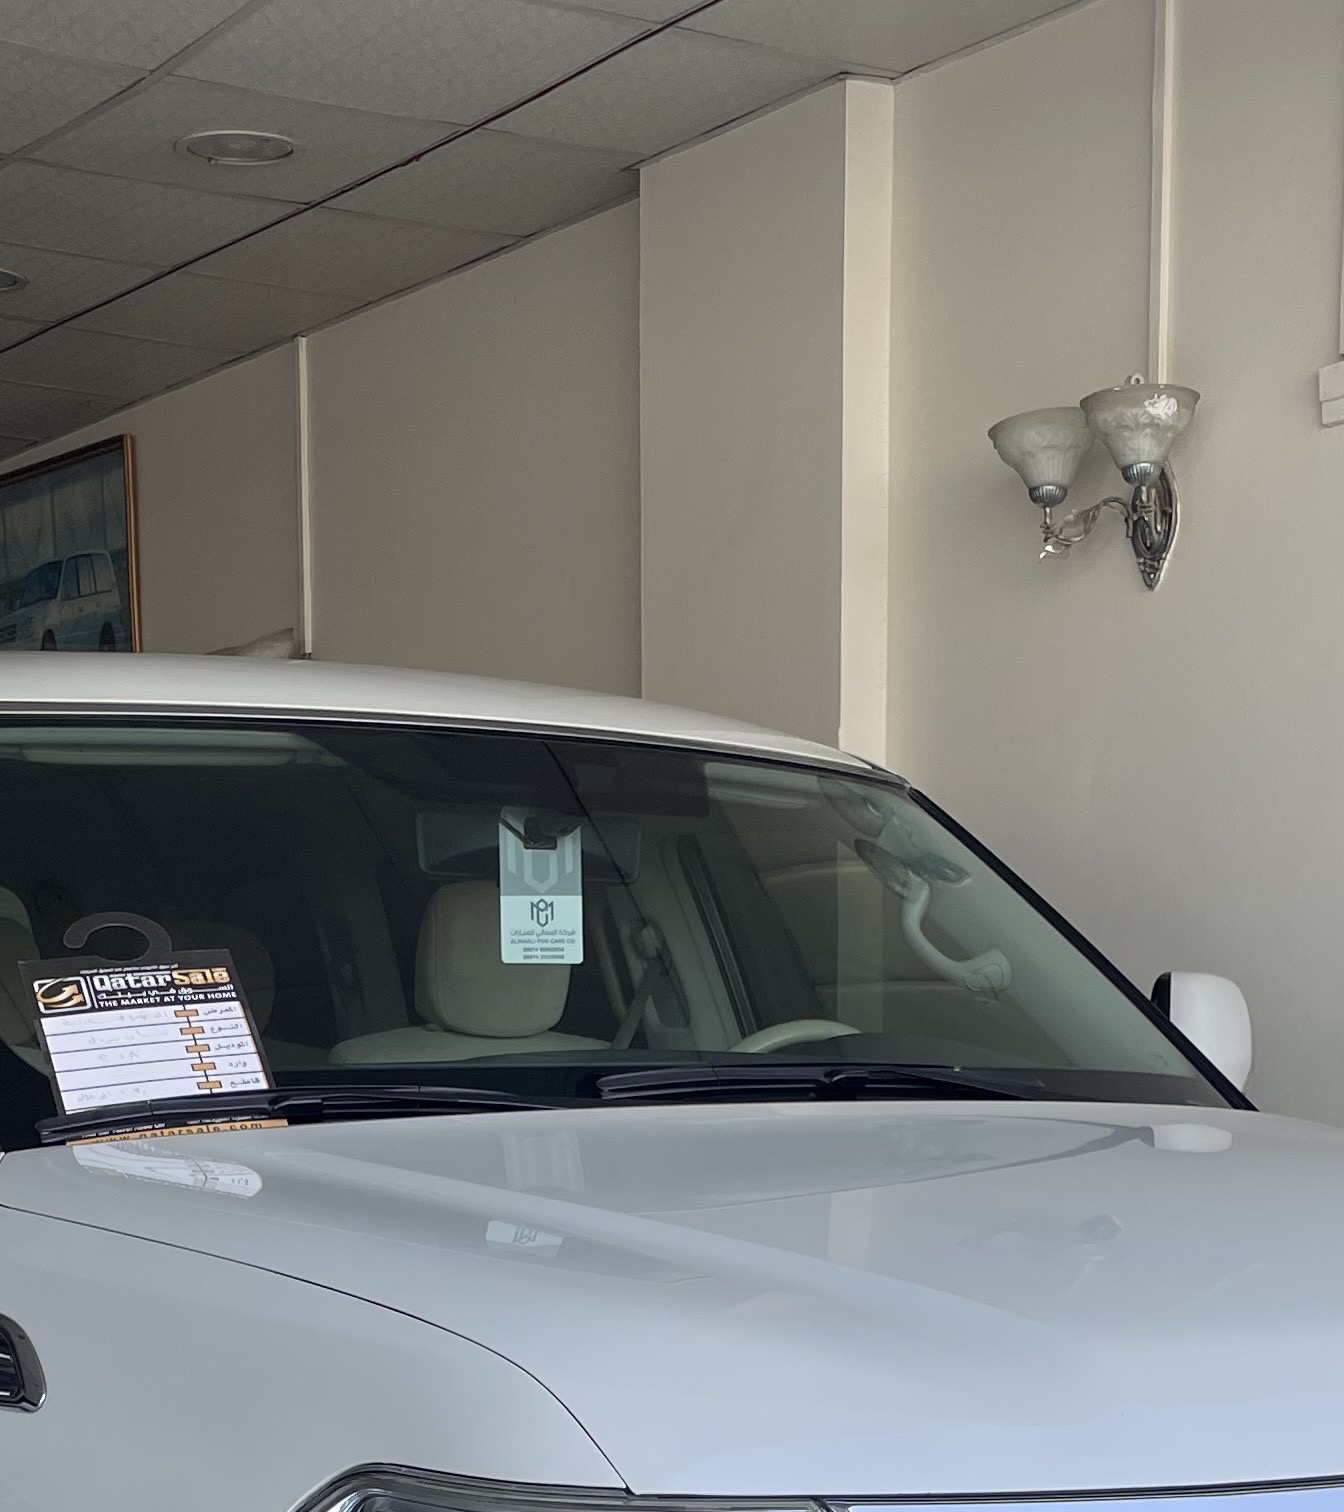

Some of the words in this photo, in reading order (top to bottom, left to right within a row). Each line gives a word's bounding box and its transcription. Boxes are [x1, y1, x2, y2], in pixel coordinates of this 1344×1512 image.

[93, 967, 230, 991] QatarSale
[98, 1000, 118, 1008] THE
[120, 997, 161, 1006] MARKET
[163, 995, 176, 1003] AT
[177, 993, 206, 1001] YOUR
[207, 991, 237, 1000] HOME
